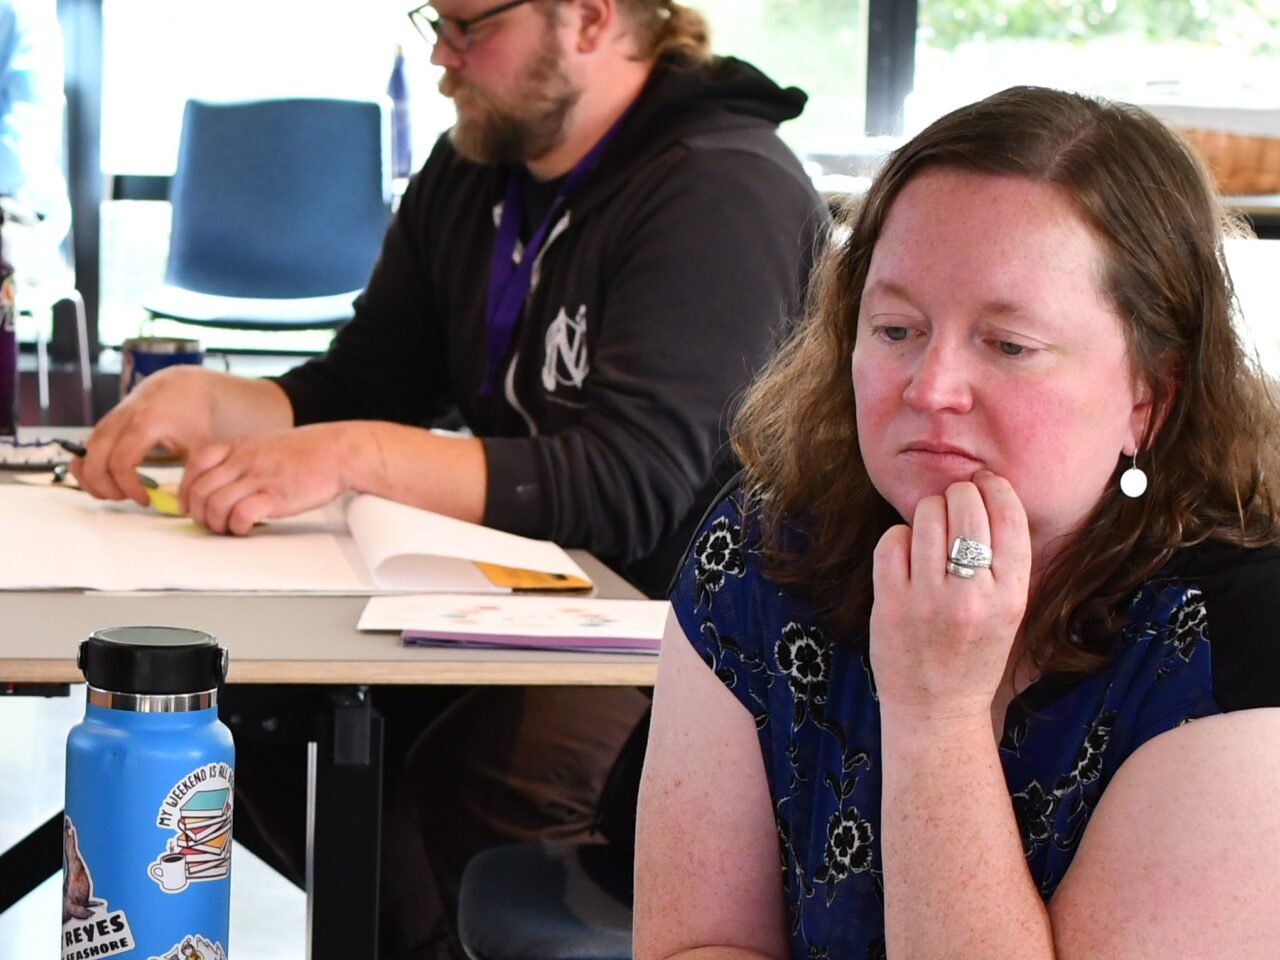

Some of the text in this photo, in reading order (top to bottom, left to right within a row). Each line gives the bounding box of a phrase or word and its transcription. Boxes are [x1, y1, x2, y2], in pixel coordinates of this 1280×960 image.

[209, 764, 217, 778] IS
[165, 768, 207, 808] WEEKEND
[158, 809, 173, 827] MY
[64, 914, 124, 947] REYES
